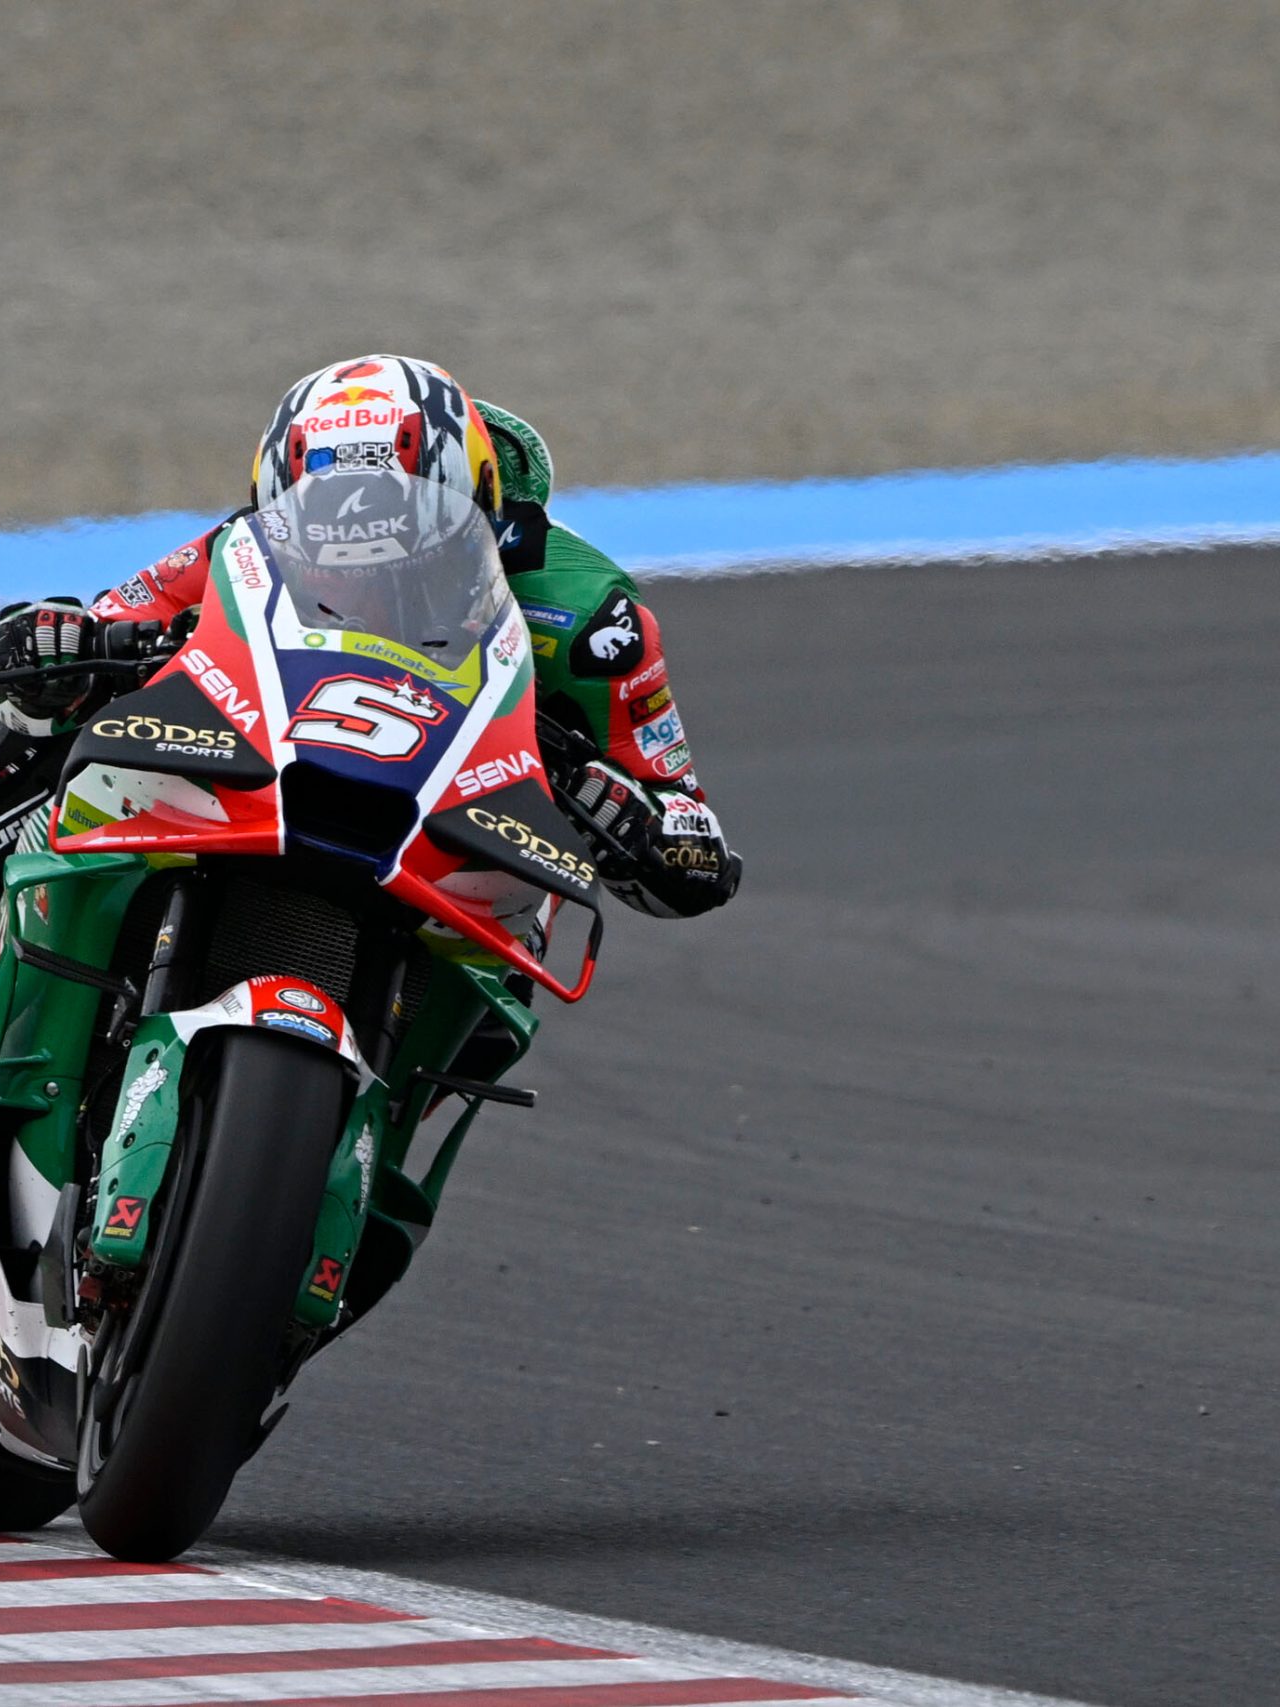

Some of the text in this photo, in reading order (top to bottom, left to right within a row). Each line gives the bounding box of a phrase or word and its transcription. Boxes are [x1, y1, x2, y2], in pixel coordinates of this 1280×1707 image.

[302, 407, 404, 433] Red Bull
[336, 442, 392, 458] QUAD
[336, 457, 394, 472] LOCK
[305, 514, 411, 541] SHARK
[233, 546, 267, 590] Castrol
[354, 640, 437, 679] ultimate
[180, 648, 261, 734] SENA
[282, 674, 448, 762] 5
[154, 742, 235, 760] SPORTS
[454, 750, 542, 797] SENA
[520, 848, 590, 890] SPORTS
[262, 1012, 333, 1039] DAYCO
